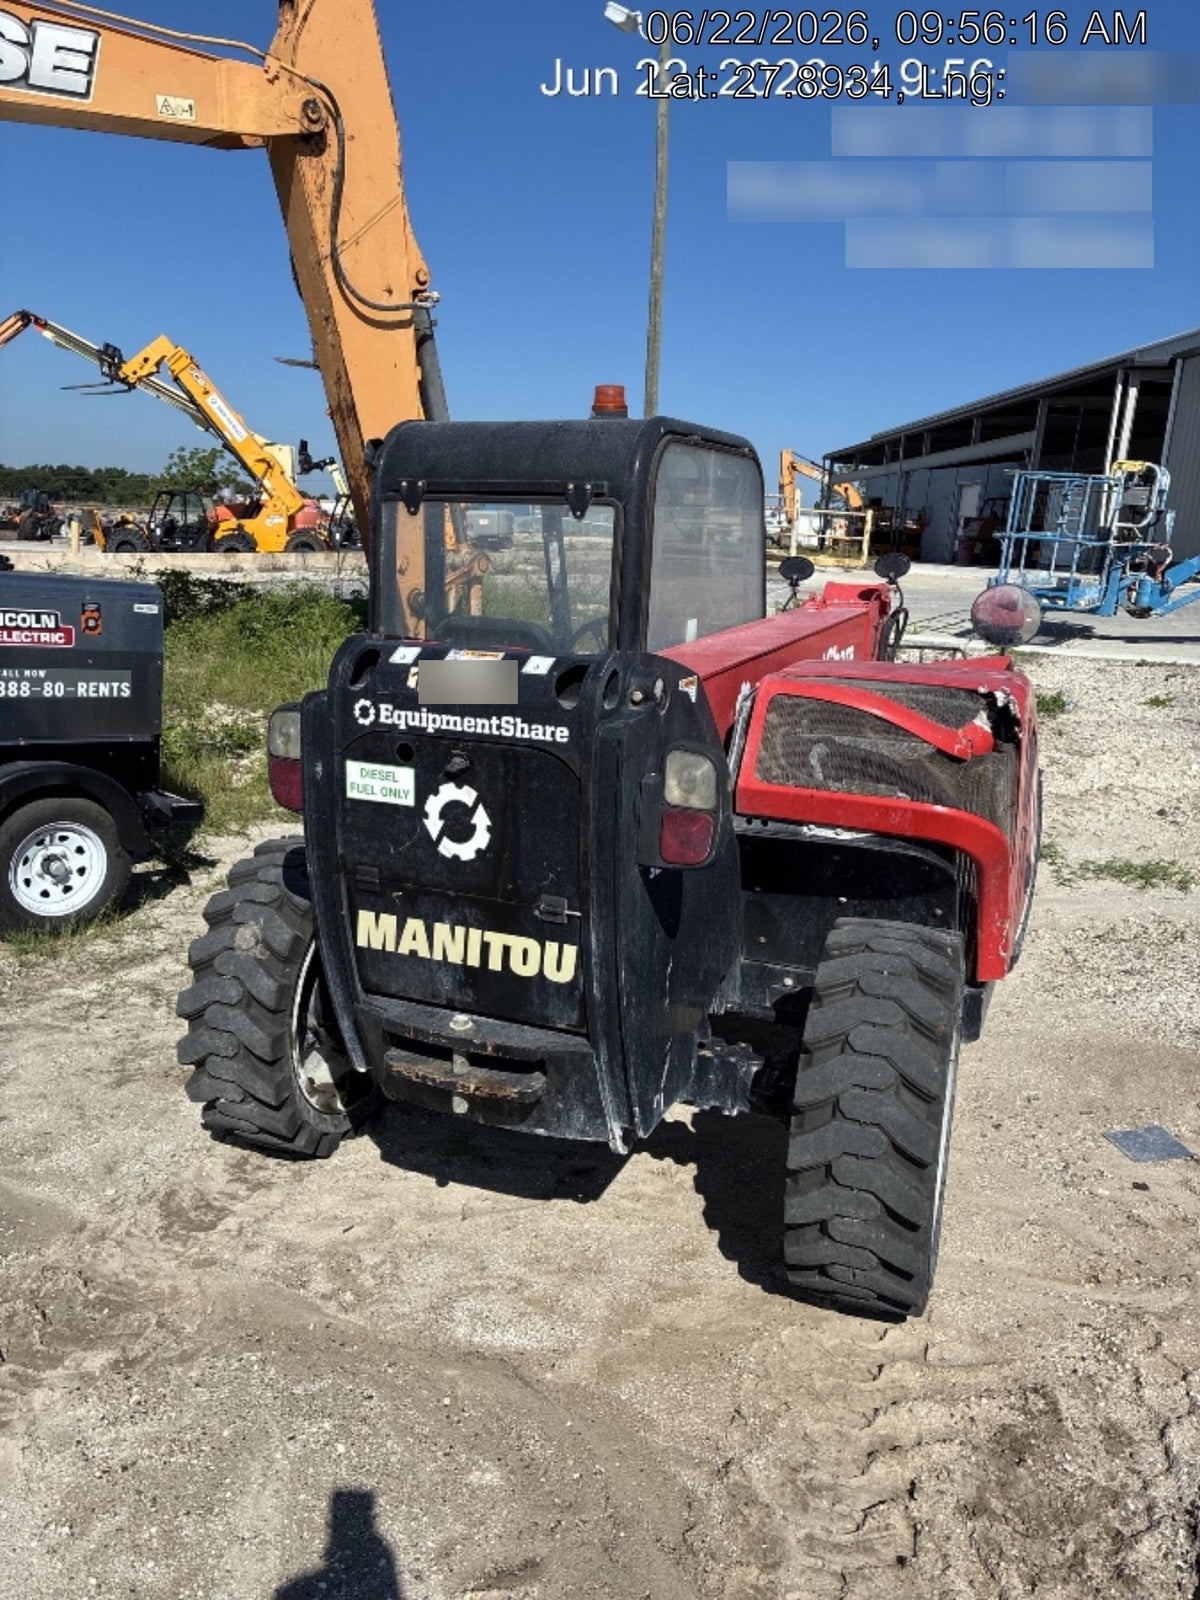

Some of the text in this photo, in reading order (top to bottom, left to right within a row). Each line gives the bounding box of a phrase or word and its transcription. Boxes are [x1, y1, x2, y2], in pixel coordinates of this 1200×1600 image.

[0, 669, 20, 678] ALL
[378, 703, 570, 743] EquipmentShare
[360, 767, 399, 783] DIESEL
[349, 782, 410, 800] FUEL ONLY
[356, 909, 578, 983] MANITOU
